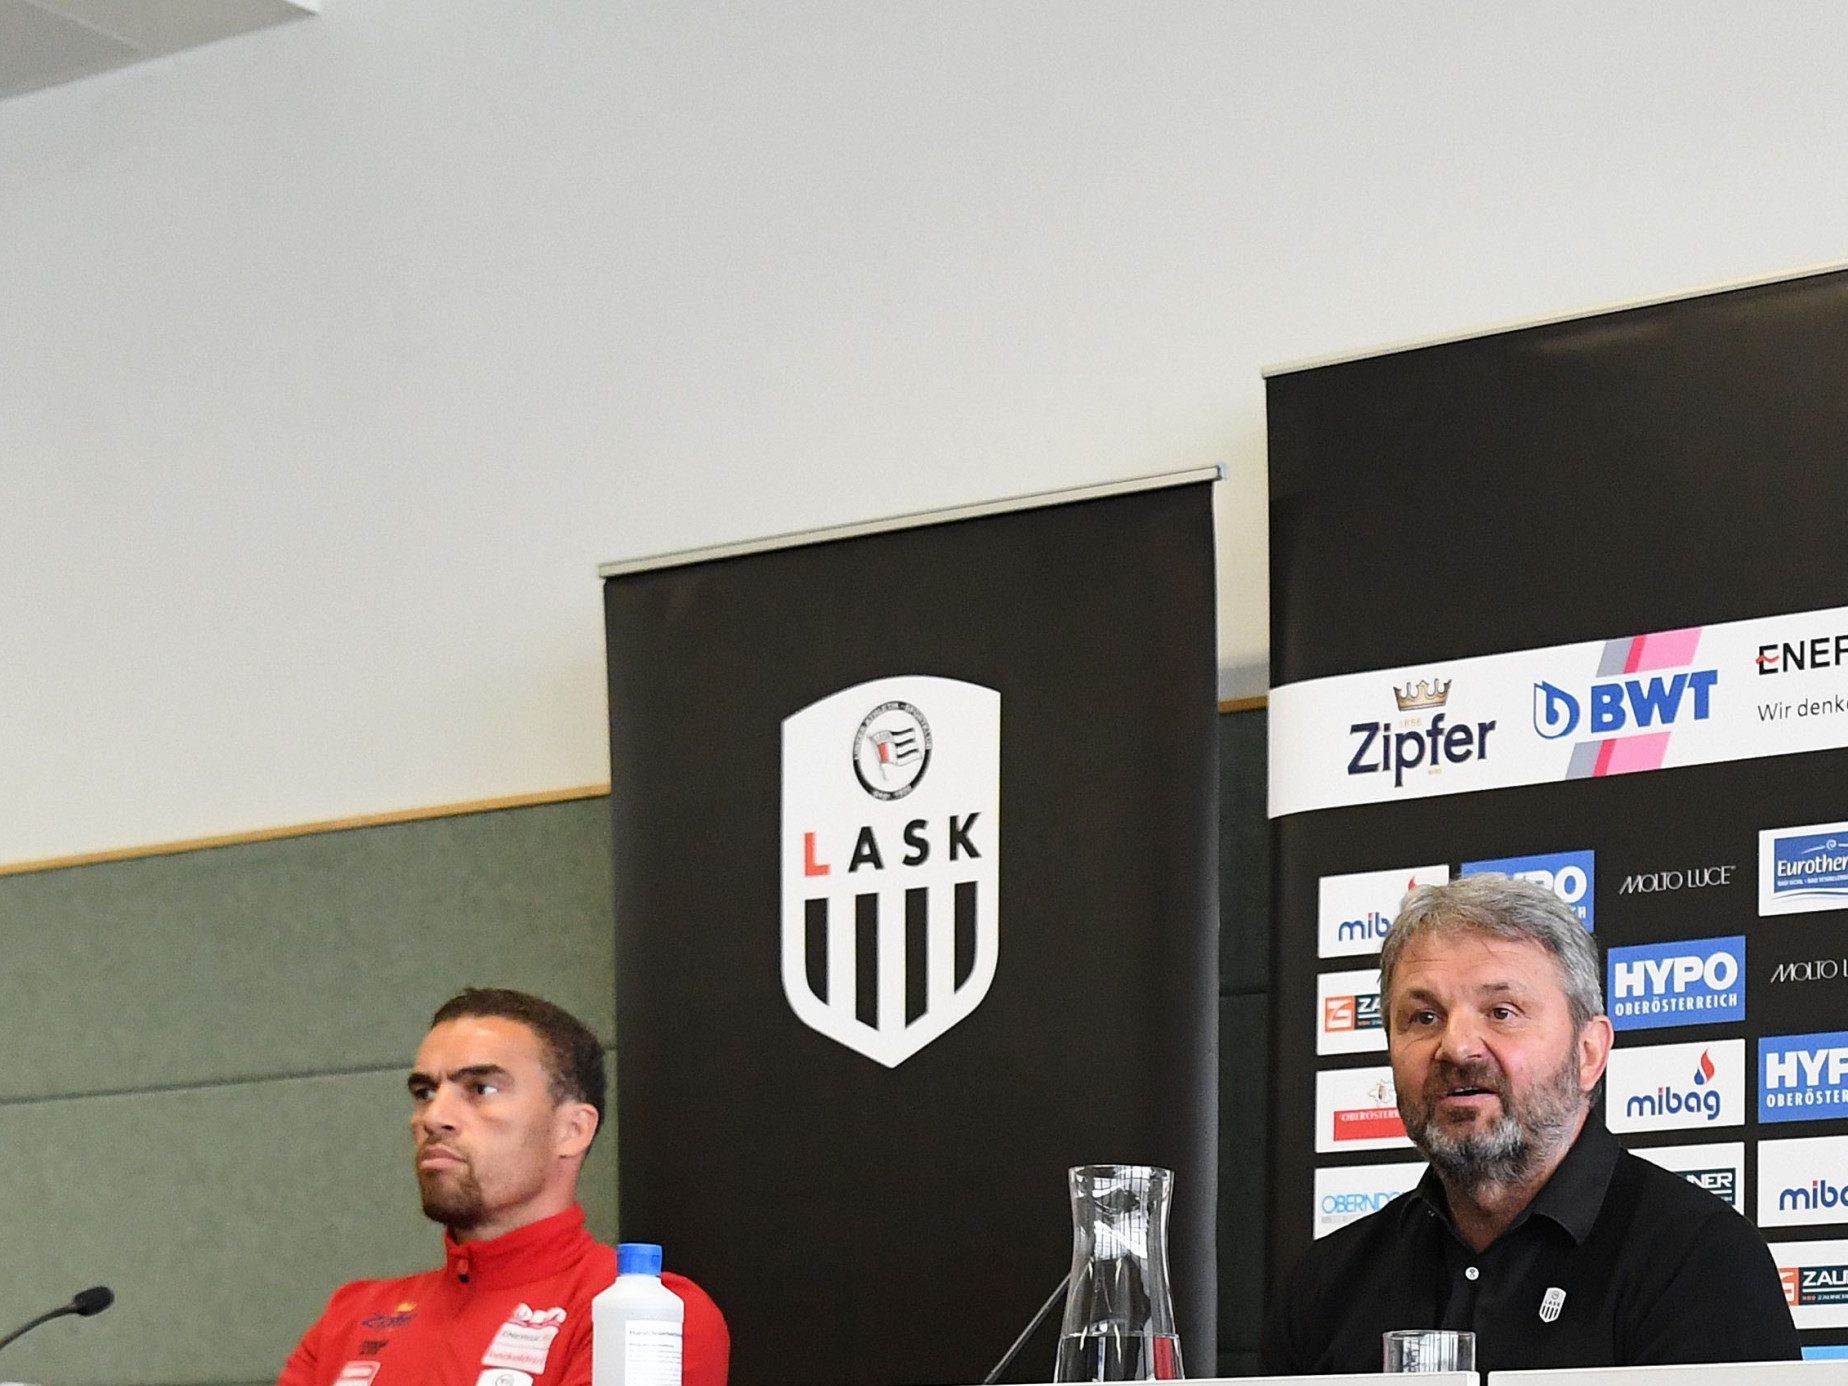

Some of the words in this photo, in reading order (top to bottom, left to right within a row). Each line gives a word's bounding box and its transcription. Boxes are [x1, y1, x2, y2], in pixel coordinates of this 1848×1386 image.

[1589, 670, 1719, 734] BWT
[1757, 702, 1792, 722] Wir
[1347, 712, 1497, 788] Zipfer
[803, 811, 983, 878] LASK
[1619, 871, 1683, 896] MOLTO
[1687, 866, 1731, 889] LUCE
[1339, 911, 1392, 942] mib
[1614, 951, 1739, 998] HYPO
[1770, 960, 1839, 984] MOLTO
[1614, 994, 1738, 1016] OBERÖSTERREICH
[1626, 1086, 1721, 1121] mibag
